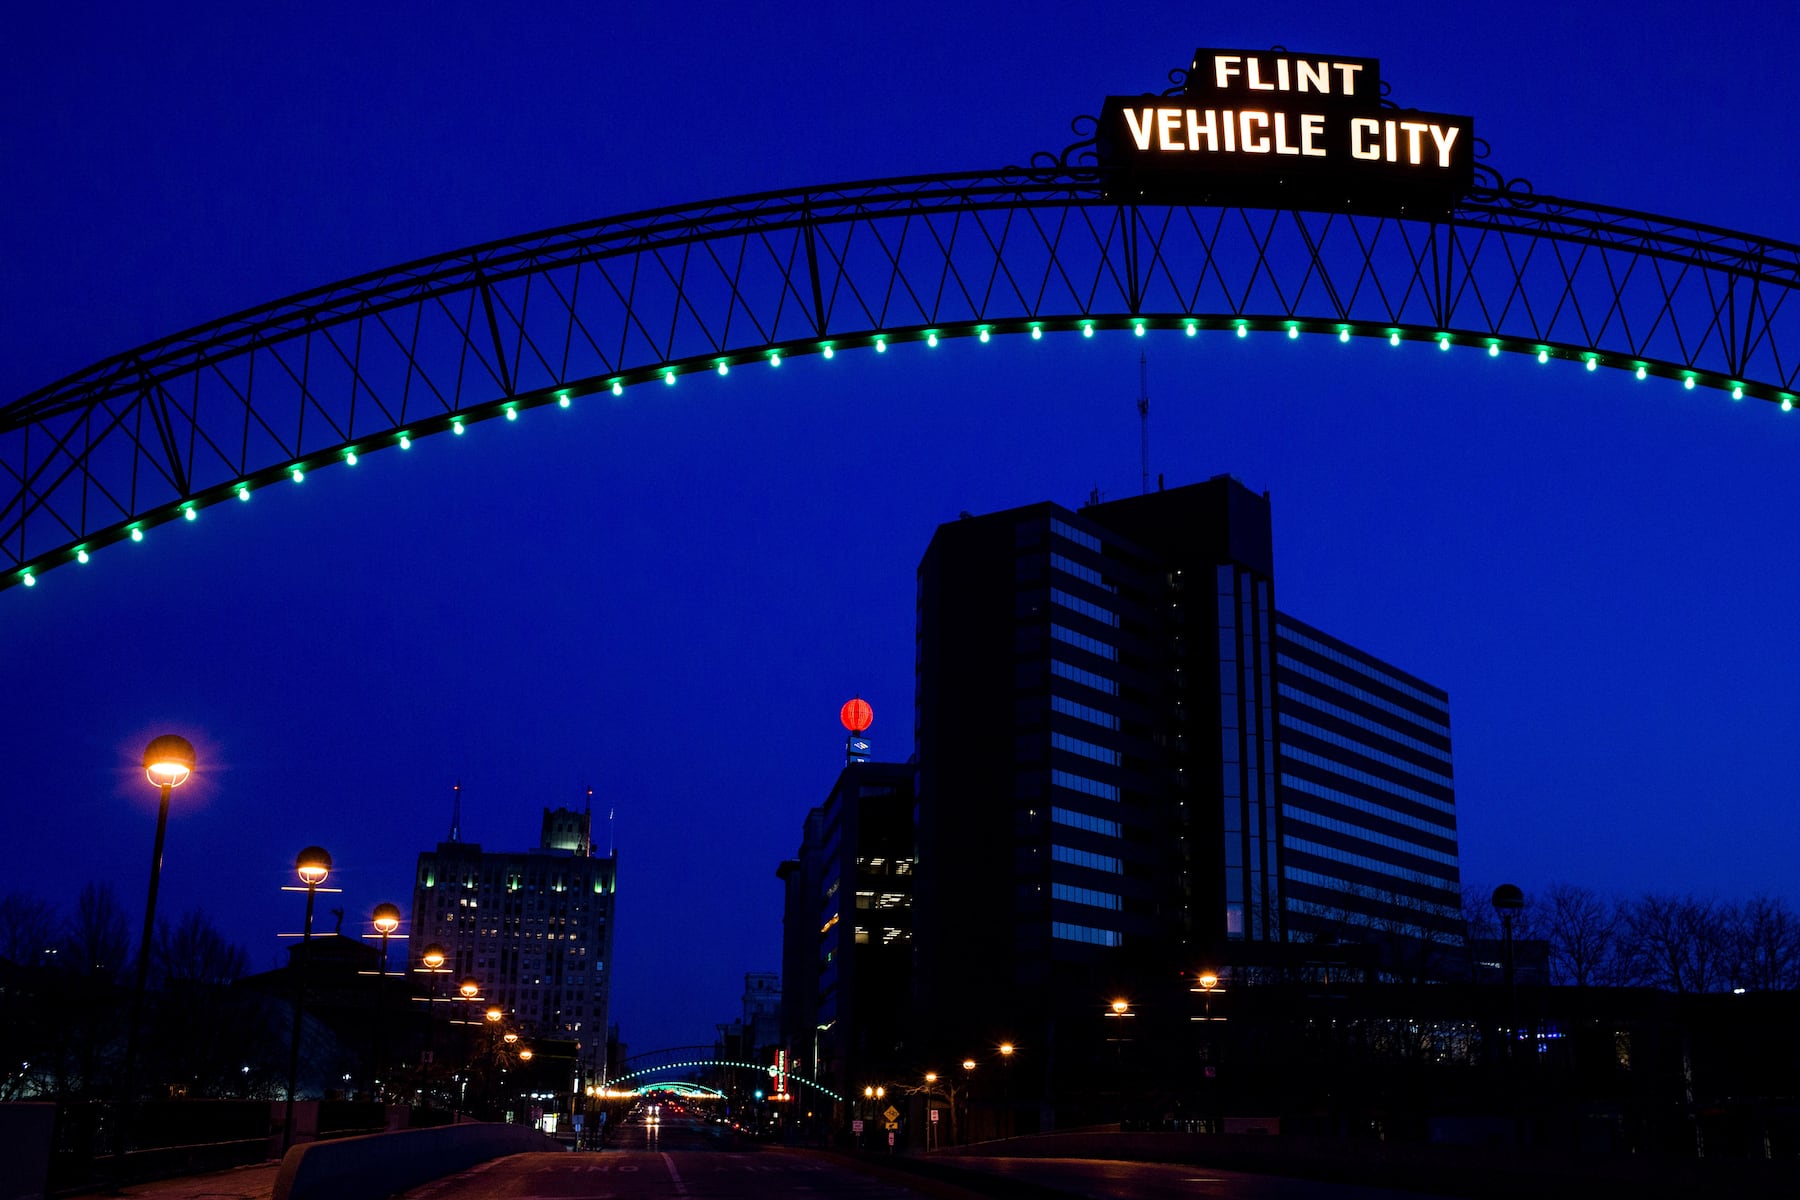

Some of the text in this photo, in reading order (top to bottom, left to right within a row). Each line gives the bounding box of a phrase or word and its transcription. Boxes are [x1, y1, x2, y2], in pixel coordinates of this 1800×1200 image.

[1214, 55, 1363, 96] FLINT
[1122, 107, 1460, 168] VEHICLE CITY
